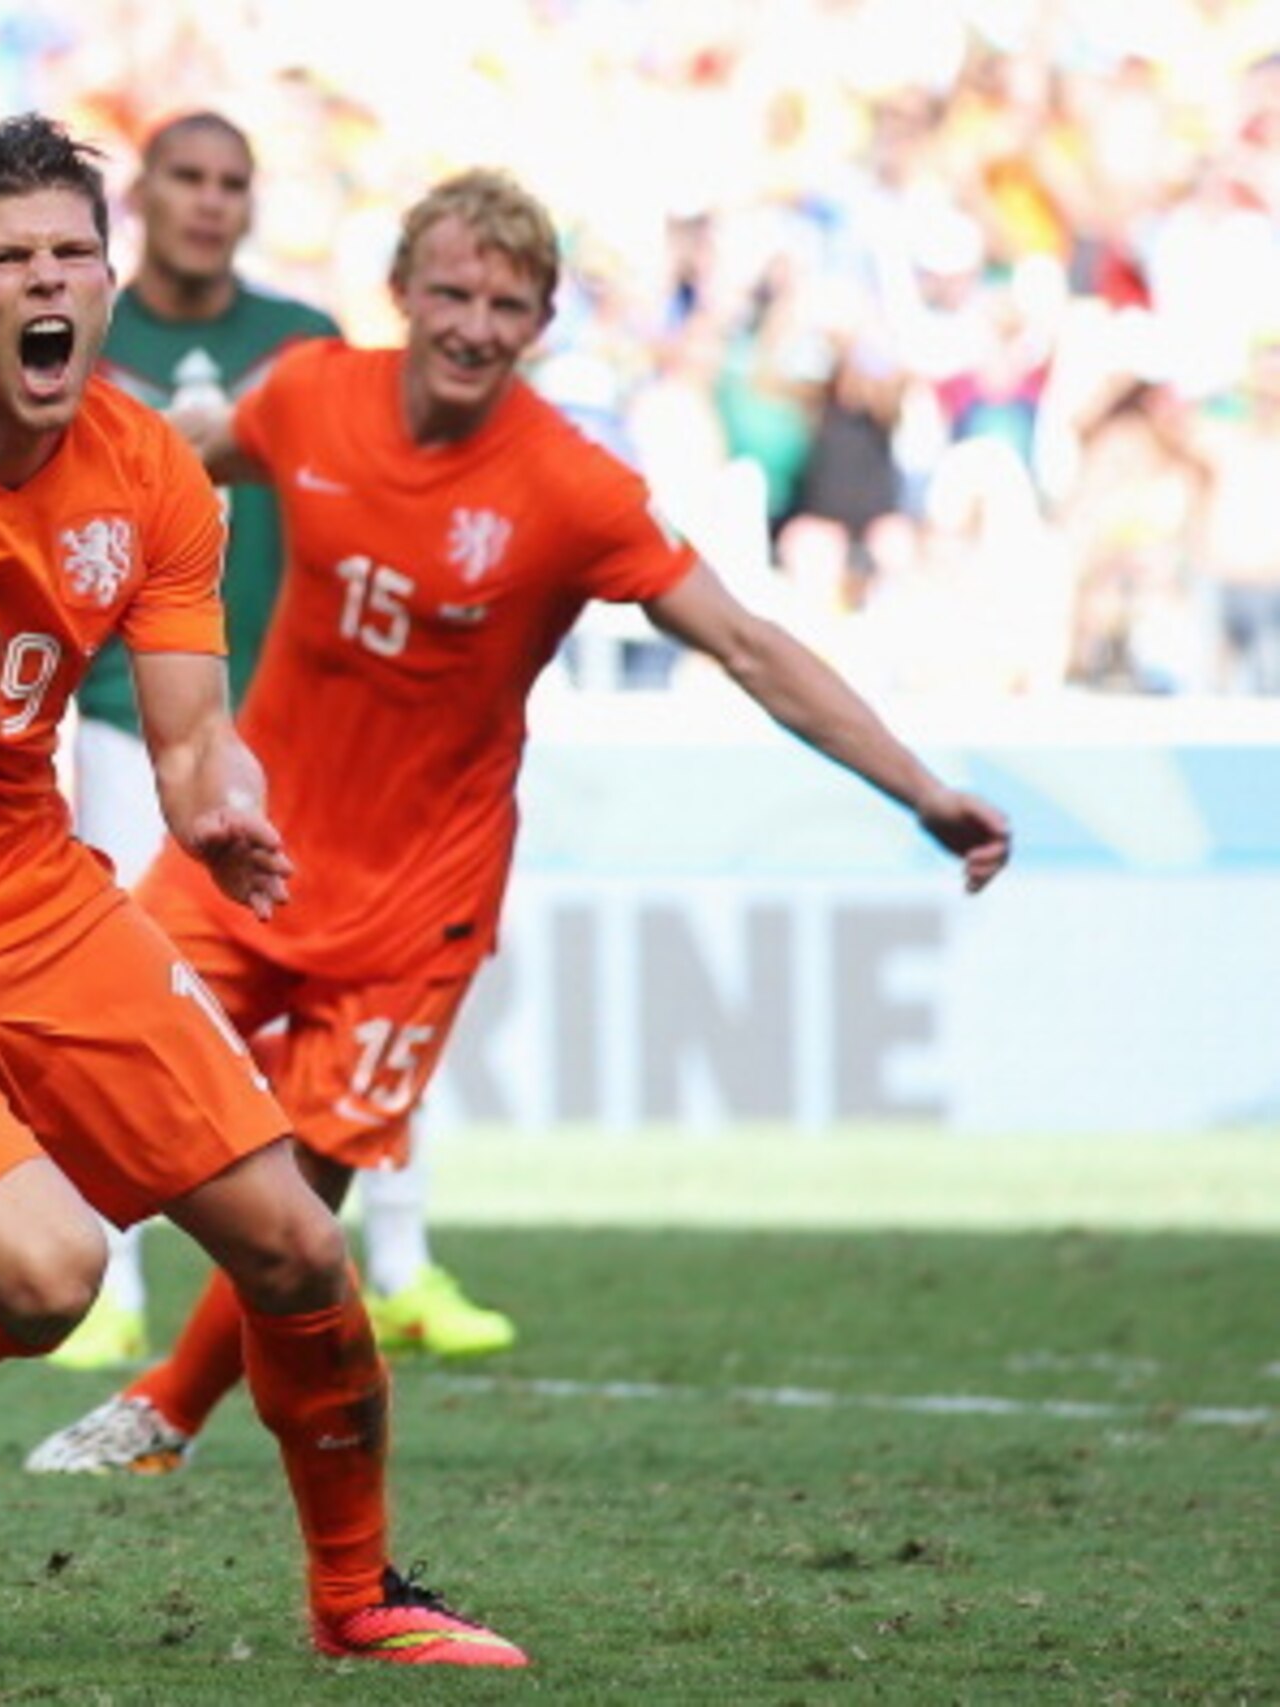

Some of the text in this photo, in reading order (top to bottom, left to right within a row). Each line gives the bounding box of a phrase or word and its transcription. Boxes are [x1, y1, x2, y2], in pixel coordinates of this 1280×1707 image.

[336, 554, 415, 657] 15
[171, 960, 250, 1057] 1
[351, 1018, 436, 1112] 15
